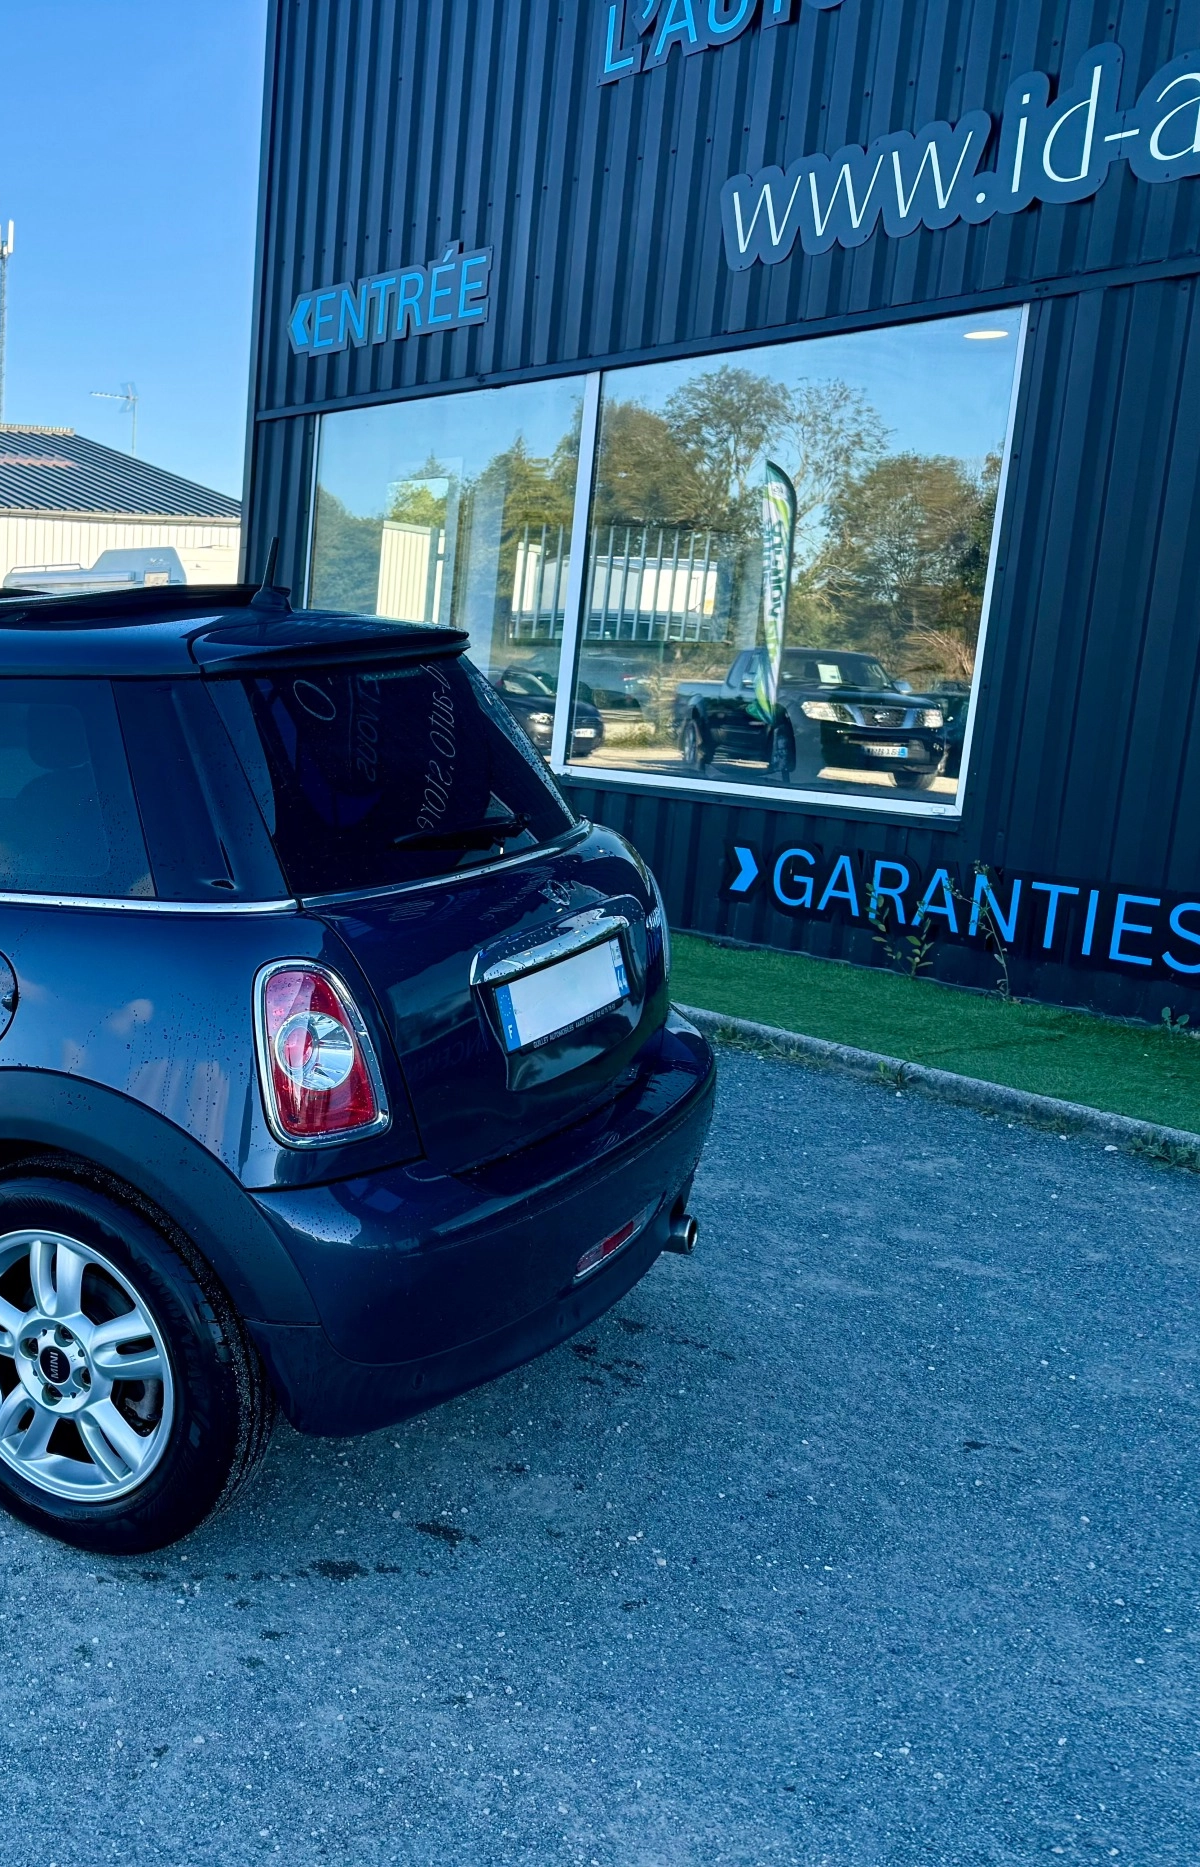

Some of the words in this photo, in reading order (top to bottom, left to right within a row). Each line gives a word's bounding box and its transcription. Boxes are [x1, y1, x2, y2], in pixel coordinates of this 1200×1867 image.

[604, 0, 781, 74] L'AU
[313, 250, 489, 348] ENTRÉE
[773, 848, 1200, 974] GARANTIES
[50, 1351, 59, 1379] MINI
